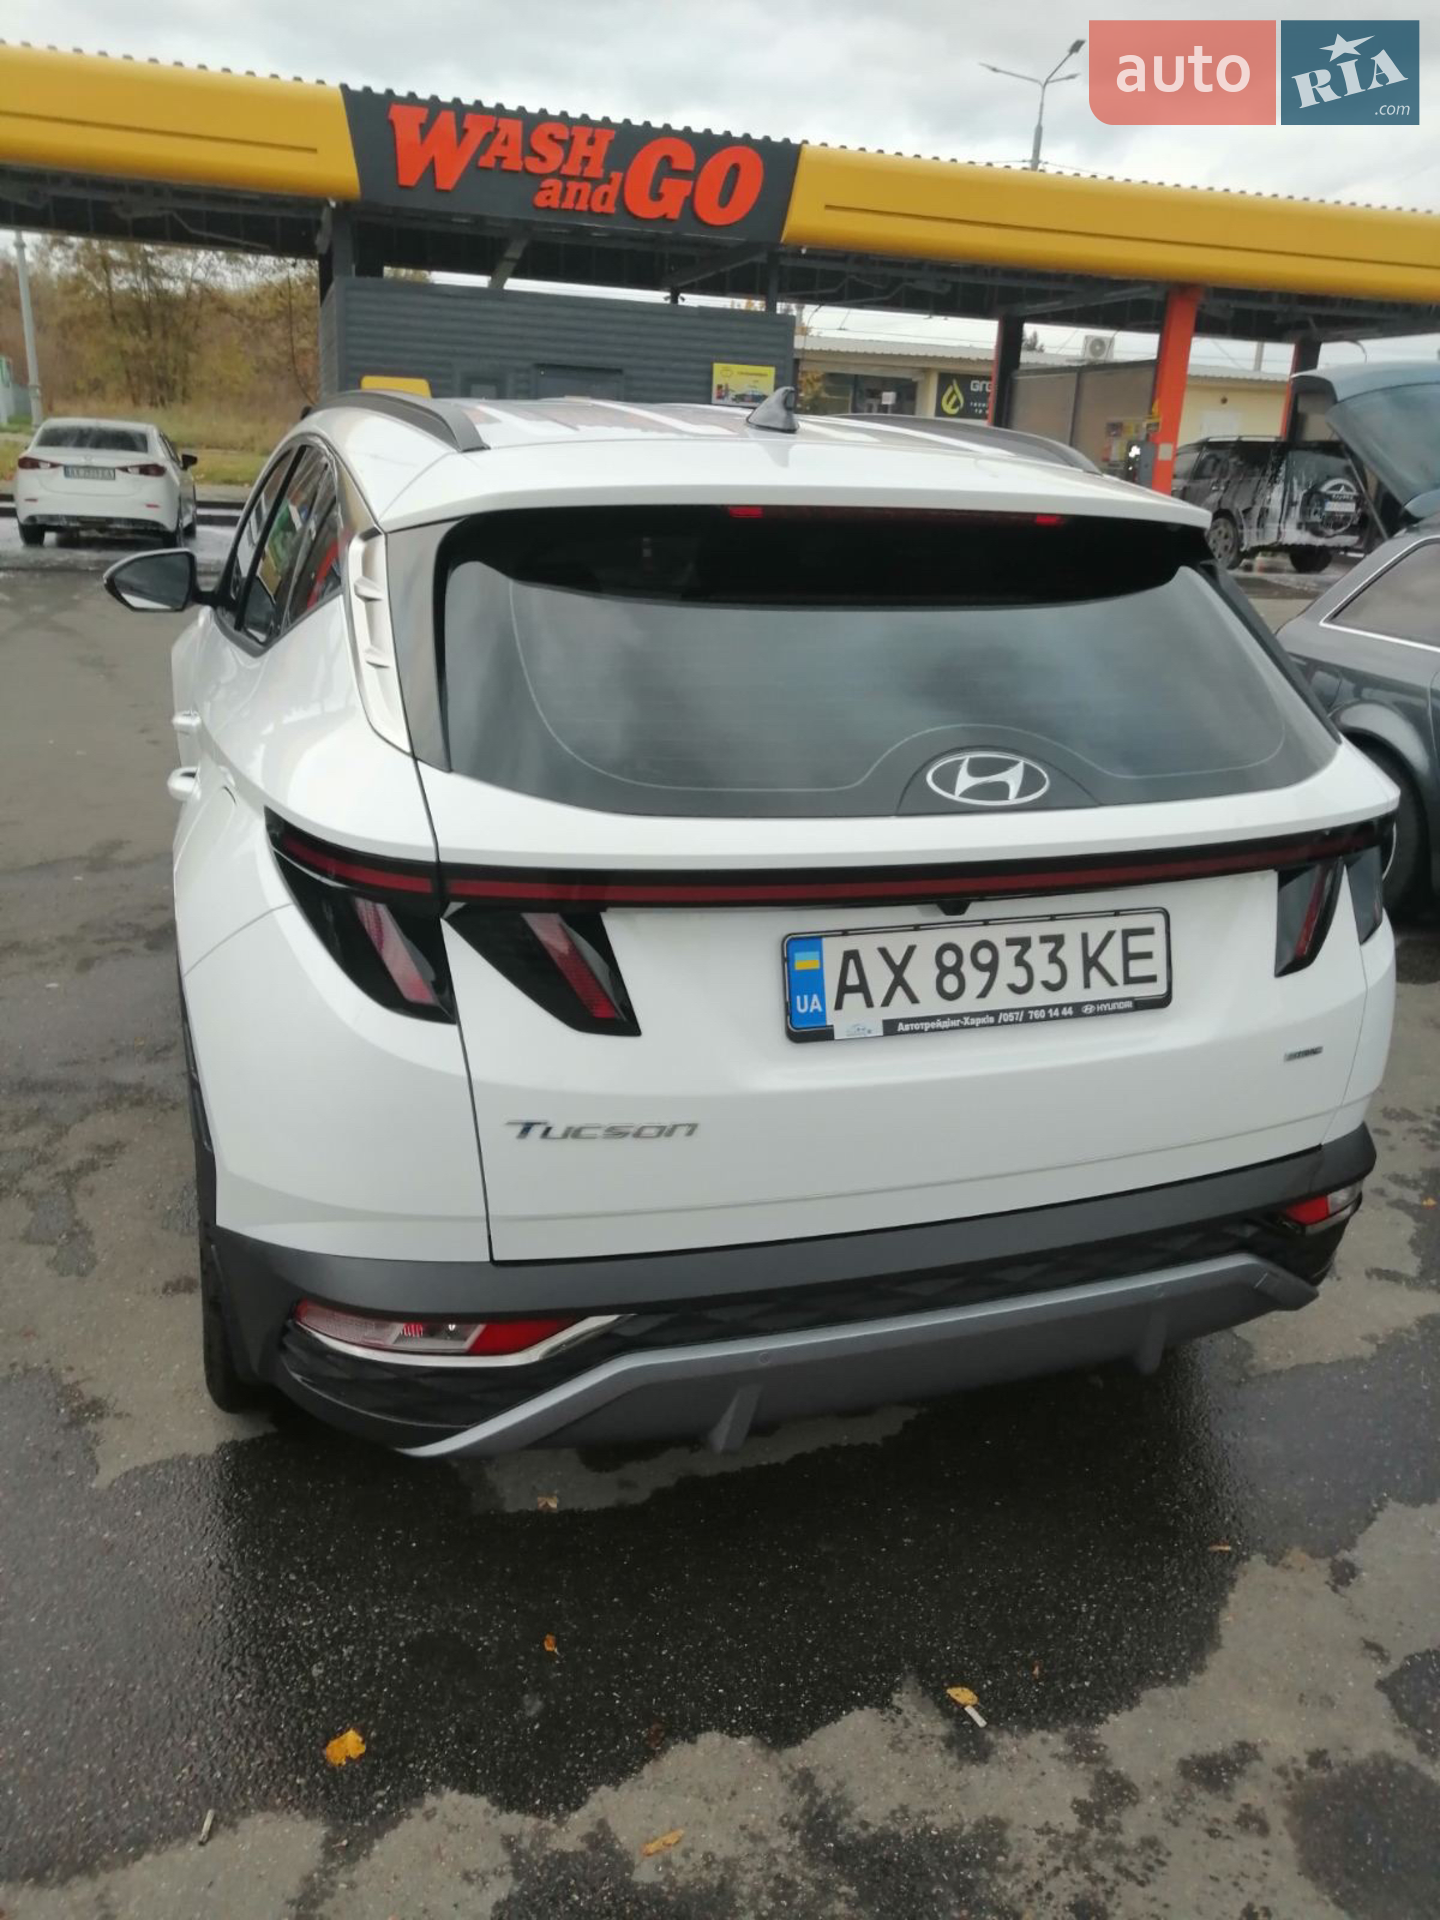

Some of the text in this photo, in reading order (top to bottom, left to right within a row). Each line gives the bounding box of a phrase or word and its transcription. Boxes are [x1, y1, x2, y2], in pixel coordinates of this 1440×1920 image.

[388, 103, 764, 226] WASH and GO
[834, 927, 1158, 1010] AX 8933 KE
[796, 993, 822, 1013] UA
[897, 1000, 1133, 1032] Автотрейдінг-Харків /057/ 760 14 44 HYUNDAI
